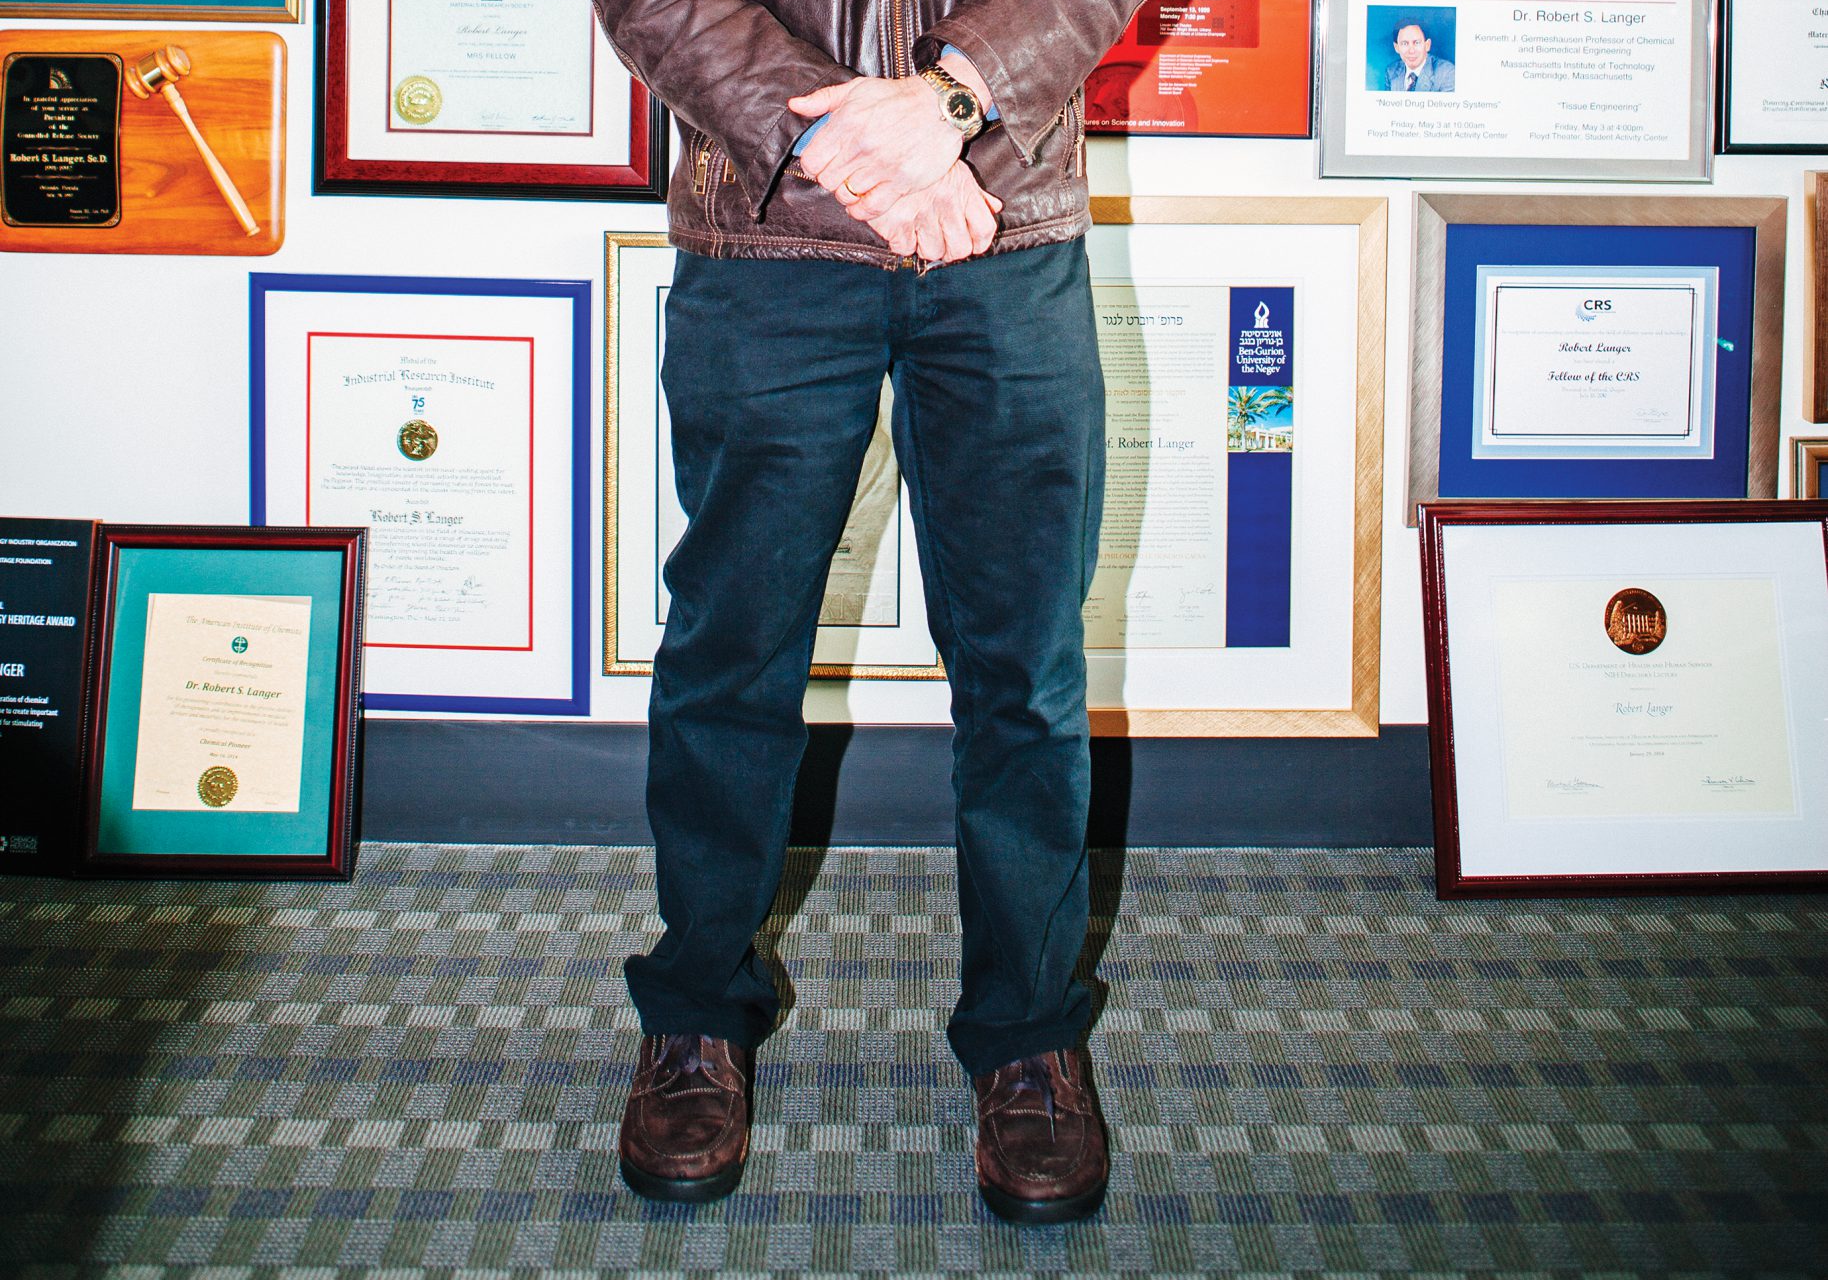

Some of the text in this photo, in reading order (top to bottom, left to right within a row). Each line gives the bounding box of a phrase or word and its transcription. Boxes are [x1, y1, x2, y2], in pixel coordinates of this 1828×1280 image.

[1513, 10, 1646, 26] Dr. Robert S. Langer
[456, 24, 528, 40] Robert Langer
[1474, 34, 1675, 45] Kenneth J. Germeshausen Professor of Chemical
[466, 52, 517, 60] MRS FELLOW
[1536, 45, 1580, 54] Biomedical
[1582, 46, 1632, 56] Engineering
[1500, 60, 1656, 73] Massachusetts Institute of Technology
[1522, 70, 1633, 82] Cambridge, Massachusetts
[10, 154, 39, 163] Robert
[1583, 299, 1612, 311] CRS
[1239, 347, 1284, 356] Ben-Gurion
[1558, 342, 1631, 355] Robert Langer
[1236, 355, 1286, 365] University of
[1242, 364, 1280, 375] the Negev
[1547, 370, 1640, 383] Fellow of the CRS
[411, 397, 426, 410] 75
[1118, 436, 1196, 451] Robert Langer
[369, 508, 408, 525] Robert
[424, 511, 464, 527] Langer
[8, 614, 76, 626] HERITAGE AWARD
[185, 680, 282, 700] Dr. Robert S. Langer
[1615, 702, 1674, 717] Robert Langer
